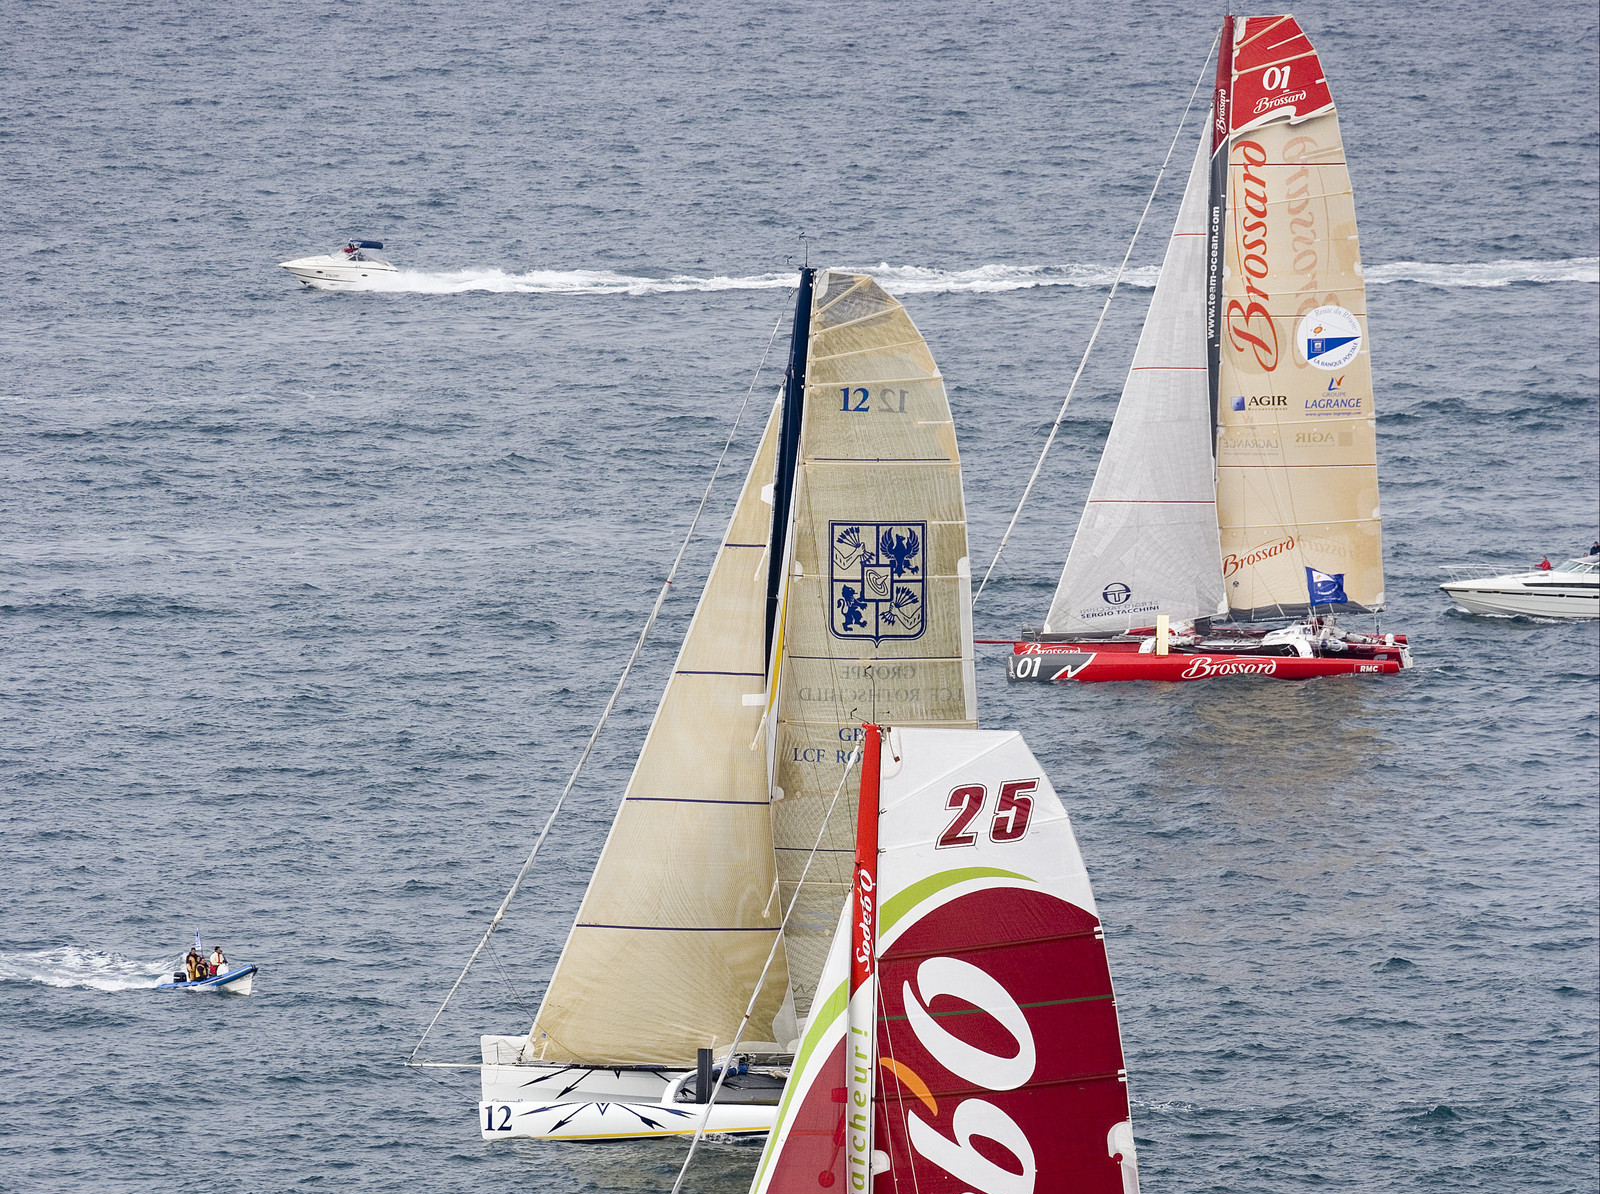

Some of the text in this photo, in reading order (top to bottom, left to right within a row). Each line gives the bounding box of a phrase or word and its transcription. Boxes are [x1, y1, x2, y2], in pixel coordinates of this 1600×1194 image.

[1262, 65, 1291, 93] 01
[1216, 88, 1227, 134] Brossard
[1253, 90, 1306, 113] Brossard
[1226, 140, 1279, 372] Brossard
[1207, 205, 1220, 339] www.team-ocean.com
[840, 387, 870, 412] 12
[1248, 395, 1288, 406] AGIR
[1304, 398, 1362, 409] LAGRANGE
[1222, 535, 1295, 579] Brossard
[1080, 605, 1160, 620] SERGIO TACCHINI
[1016, 656, 1042, 679] 01
[1181, 656, 1277, 679] Brossard
[793, 747, 826, 763] LCF
[935, 777, 1040, 851] 25
[484, 1105, 513, 1131] 12
